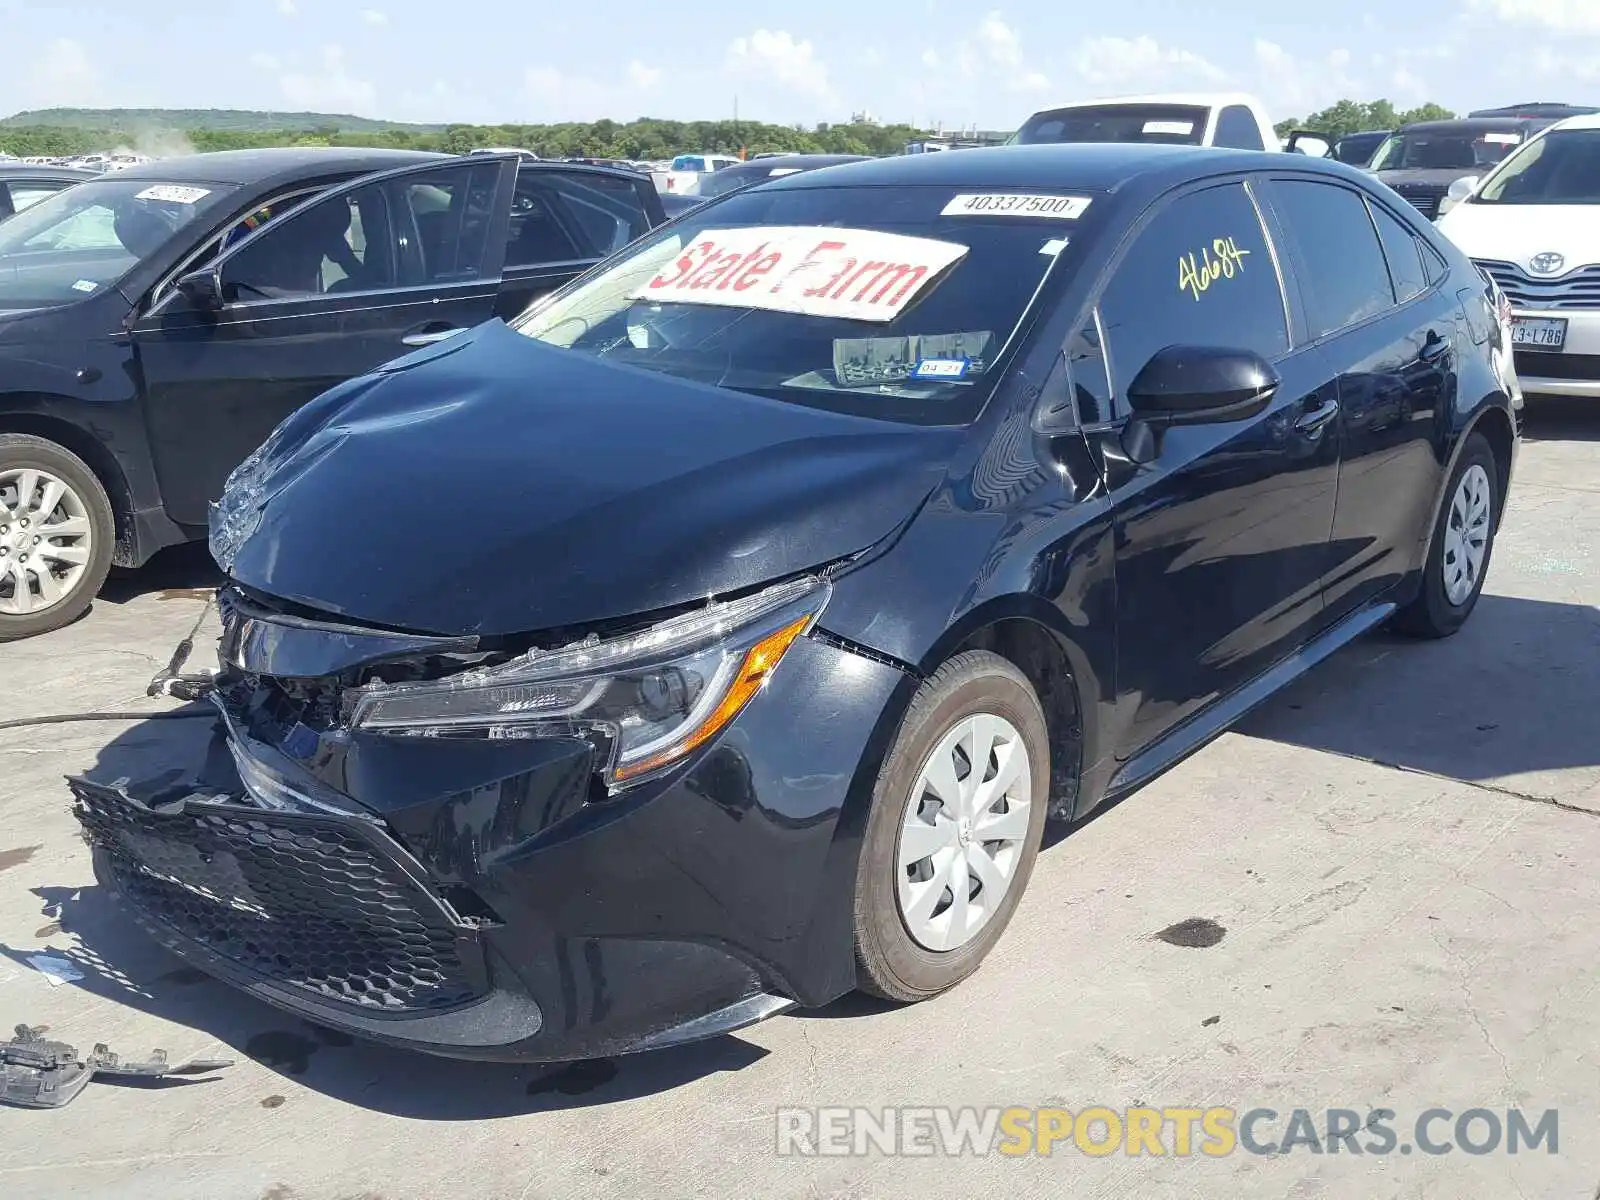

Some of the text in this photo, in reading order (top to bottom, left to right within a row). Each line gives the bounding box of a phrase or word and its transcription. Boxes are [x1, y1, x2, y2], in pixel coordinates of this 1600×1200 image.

[650, 240, 928, 306] State Farm
[1179, 236, 1250, 302] 46684
